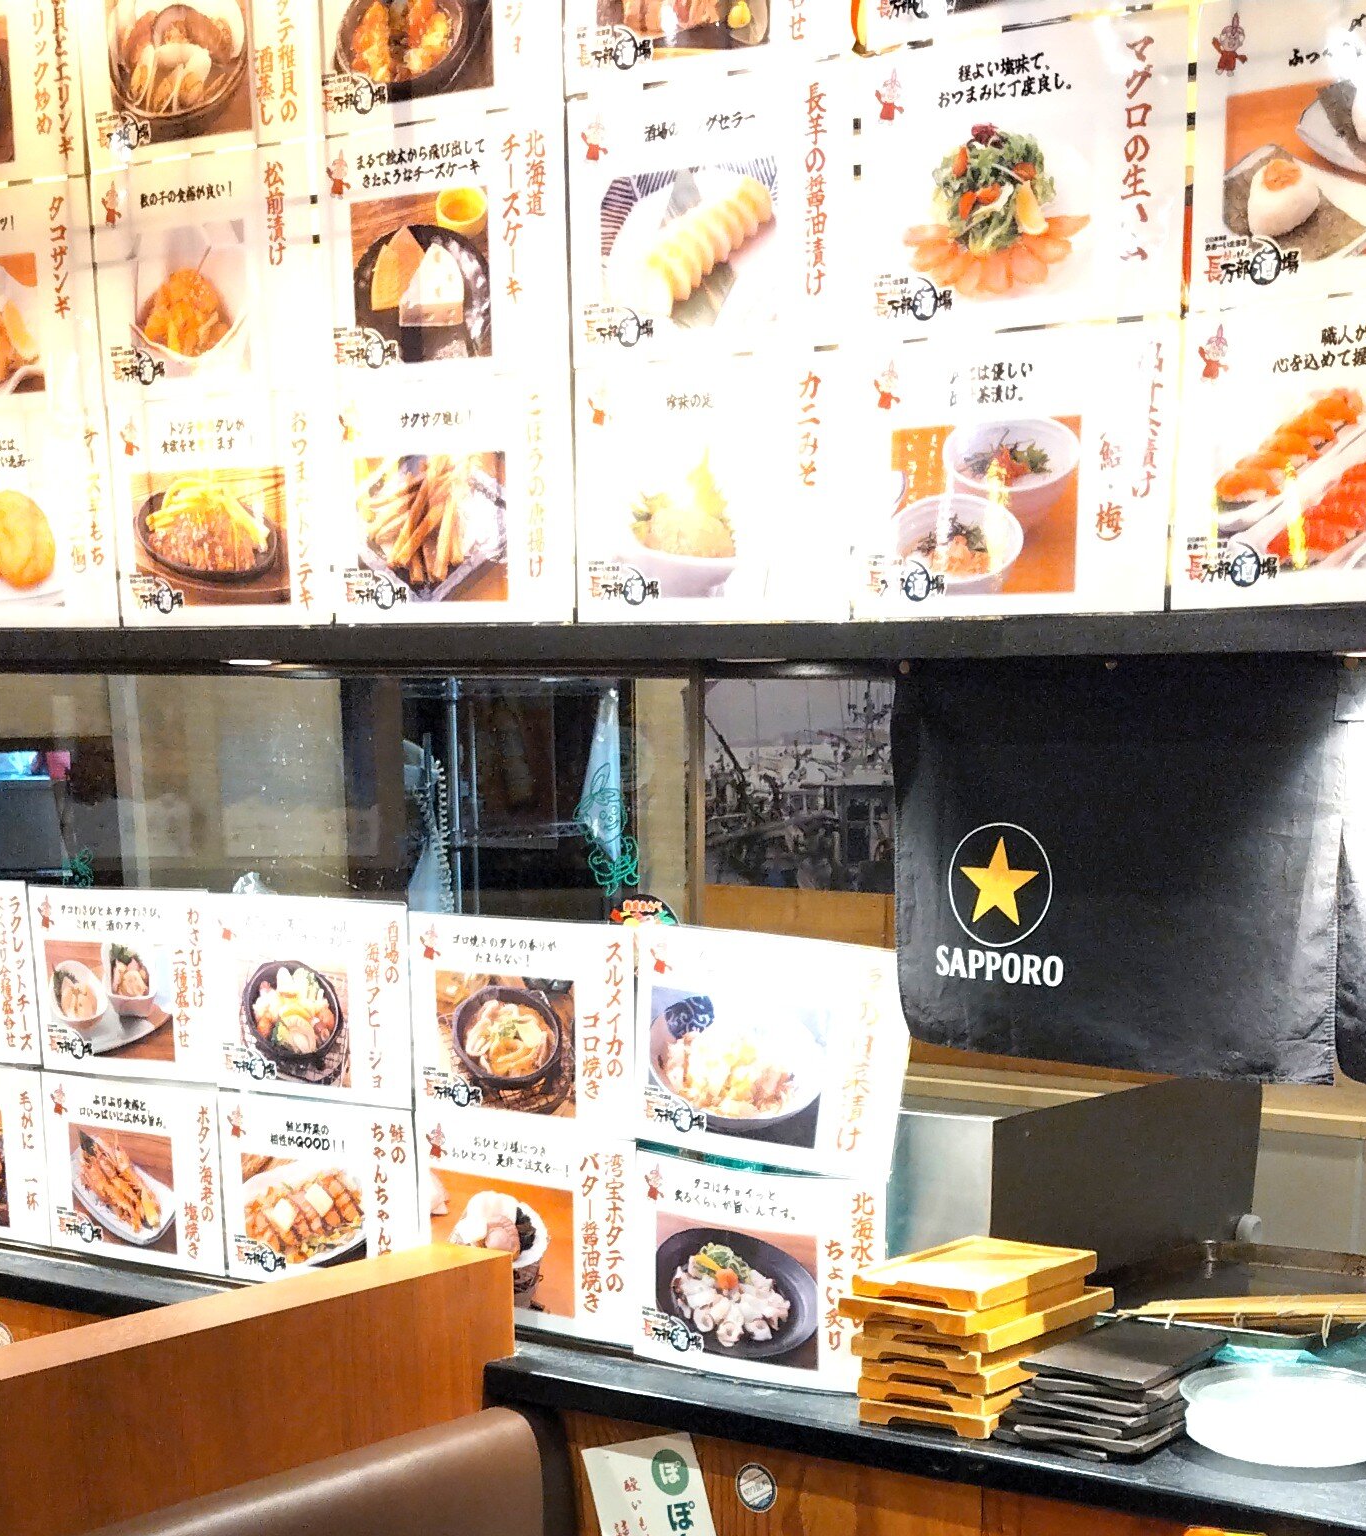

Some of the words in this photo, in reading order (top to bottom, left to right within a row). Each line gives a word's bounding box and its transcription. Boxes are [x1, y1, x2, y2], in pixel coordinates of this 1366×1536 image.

[32, 0, 53, 136] リック炒め
[52, 0, 75, 160] 貝とエリンギ
[255, 45, 275, 126] 酒蒸し
[937, 71, 1072, 109] おつまみに丁度良し。
[957, 51, 1050, 83] 程よい塩味で、
[355, 138, 486, 171] まるで絵本から飛び出して
[362, 158, 481, 188] きたようなチーズケーキ
[524, 129, 547, 217] 北海道
[643, 111, 757, 144] 酒場のグセラー
[263, 160, 286, 267] 松前漬け
[501, 133, 524, 305] チーズケーキ
[802, 80, 829, 298] 長芋の醤油漬け
[48, 195, 72, 320] タコザンギ
[796, 370, 822, 488] カニみそ
[9, 895, 33, 1051] ラクレットチーズ
[172, 949, 191, 1048] 二種盛合せ
[186, 907, 205, 1008] わさび漬け
[384, 920, 400, 984] 酒場の
[935, 944, 1065, 988] SAPPORO
[364, 942, 383, 1089] 海鮮アヒージョ
[582, 1012, 603, 1100] ゴロ焼き
[605, 941, 625, 1078] スルメイカの
[19, 1091, 35, 1149] 毛がに
[196, 1105, 214, 1223] ボタン海老の
[388, 1122, 407, 1165] 鮭の
[473, 1136, 547, 1156] おひとり様につき
[184, 1201, 201, 1260] 塩焼き
[579, 1152, 603, 1314] バター醤油焼き
[604, 1153, 625, 1293] 湾宝ホタテの
[850, 1191, 875, 1269] 北海水
[824, 1239, 845, 1351] ちょい炙り
[658, 1460, 681, 1485] ぽ
